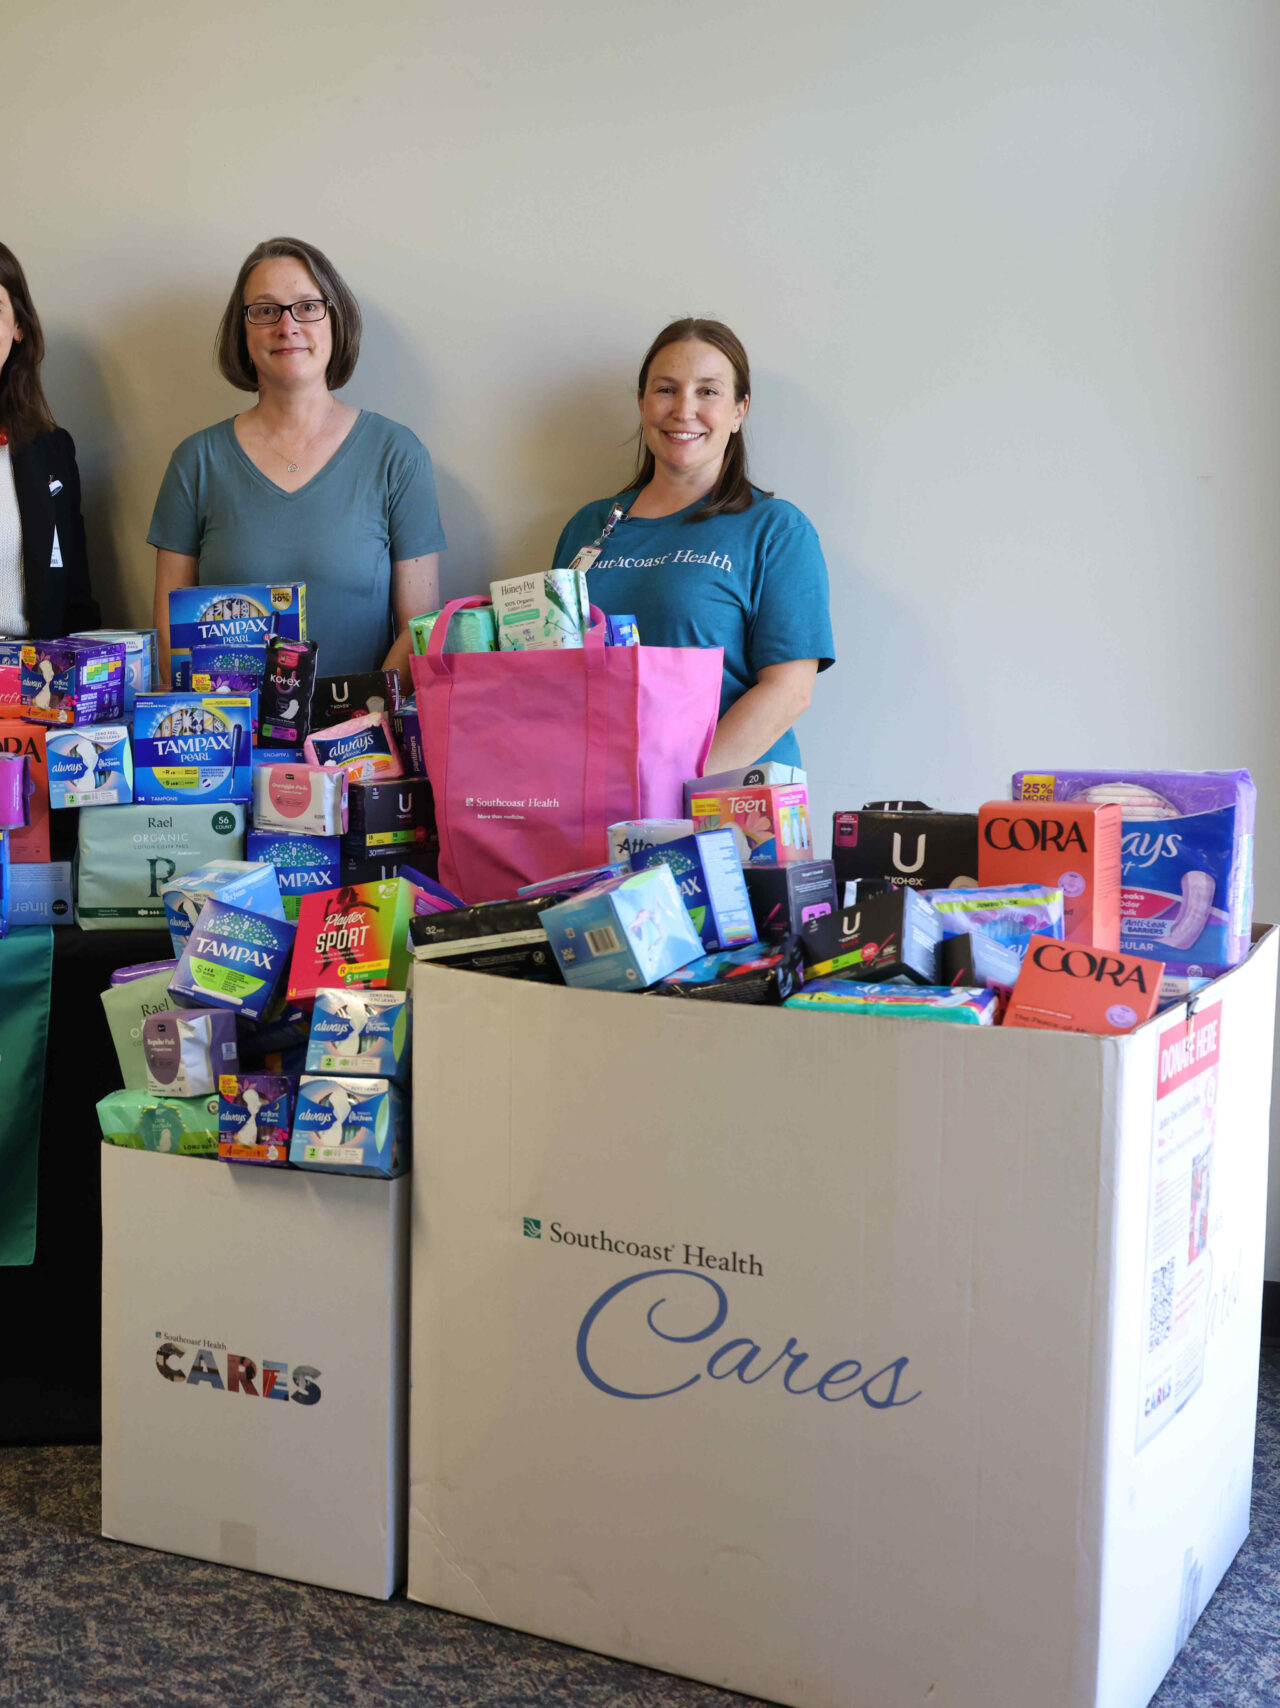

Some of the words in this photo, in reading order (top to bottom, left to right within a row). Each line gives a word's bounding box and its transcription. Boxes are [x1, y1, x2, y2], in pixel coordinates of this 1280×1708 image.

[589, 555, 667, 570] outhcoast
[672, 550, 733, 573] Health
[501, 585, 523, 596] Honey
[524, 581, 535, 591] Pot
[272, 595, 290, 604] 30%
[198, 618, 269, 638] TAMPAX
[22, 677, 43, 690] always
[331, 681, 348, 702] U
[153, 735, 231, 757] TAMPAX
[329, 732, 374, 758] always
[410, 736, 419, 771] pantiliners
[52, 762, 83, 774] always
[749, 775, 759, 783] 20
[1023, 783, 1053, 795] 25%
[399, 793, 412, 813] U
[476, 798, 525, 807] Southcoast
[529, 798, 559, 807] Health
[728, 797, 767, 814] Teen
[147, 817, 173, 828] Rael
[218, 816, 229, 824] 56
[133, 833, 189, 843] ORGANIC
[984, 817, 1088, 853] CORA
[892, 832, 926, 873] U
[1120, 832, 1182, 868] ays
[279, 871, 333, 888] MPAX
[976, 900, 1000, 908] JUMBO
[323, 911, 366, 931] Playtex
[843, 911, 861, 935] U
[1125, 919, 1167, 928] Anti-Leak
[426, 926, 436, 934] 32
[1128, 927, 1164, 935] BARRIERS
[315, 925, 370, 954] SPORT
[1120, 941, 1154, 951] GULAR
[196, 937, 275, 970] TAMPAX
[1033, 944, 1147, 994] CORA
[141, 998, 170, 1015] Rael
[314, 1019, 349, 1034] always
[1160, 1034, 1195, 1083] DONATE
[1196, 1019, 1218, 1061] HERE
[221, 1112, 247, 1125] always
[298, 1111, 332, 1124] always
[549, 1222, 675, 1263] Southcoast
[683, 1244, 765, 1277] Health
[164, 1332, 201, 1346] Southcoast
[203, 1338, 227, 1350] Health
[576, 1268, 922, 1410] Cares
[155, 1342, 322, 1406] CARES
